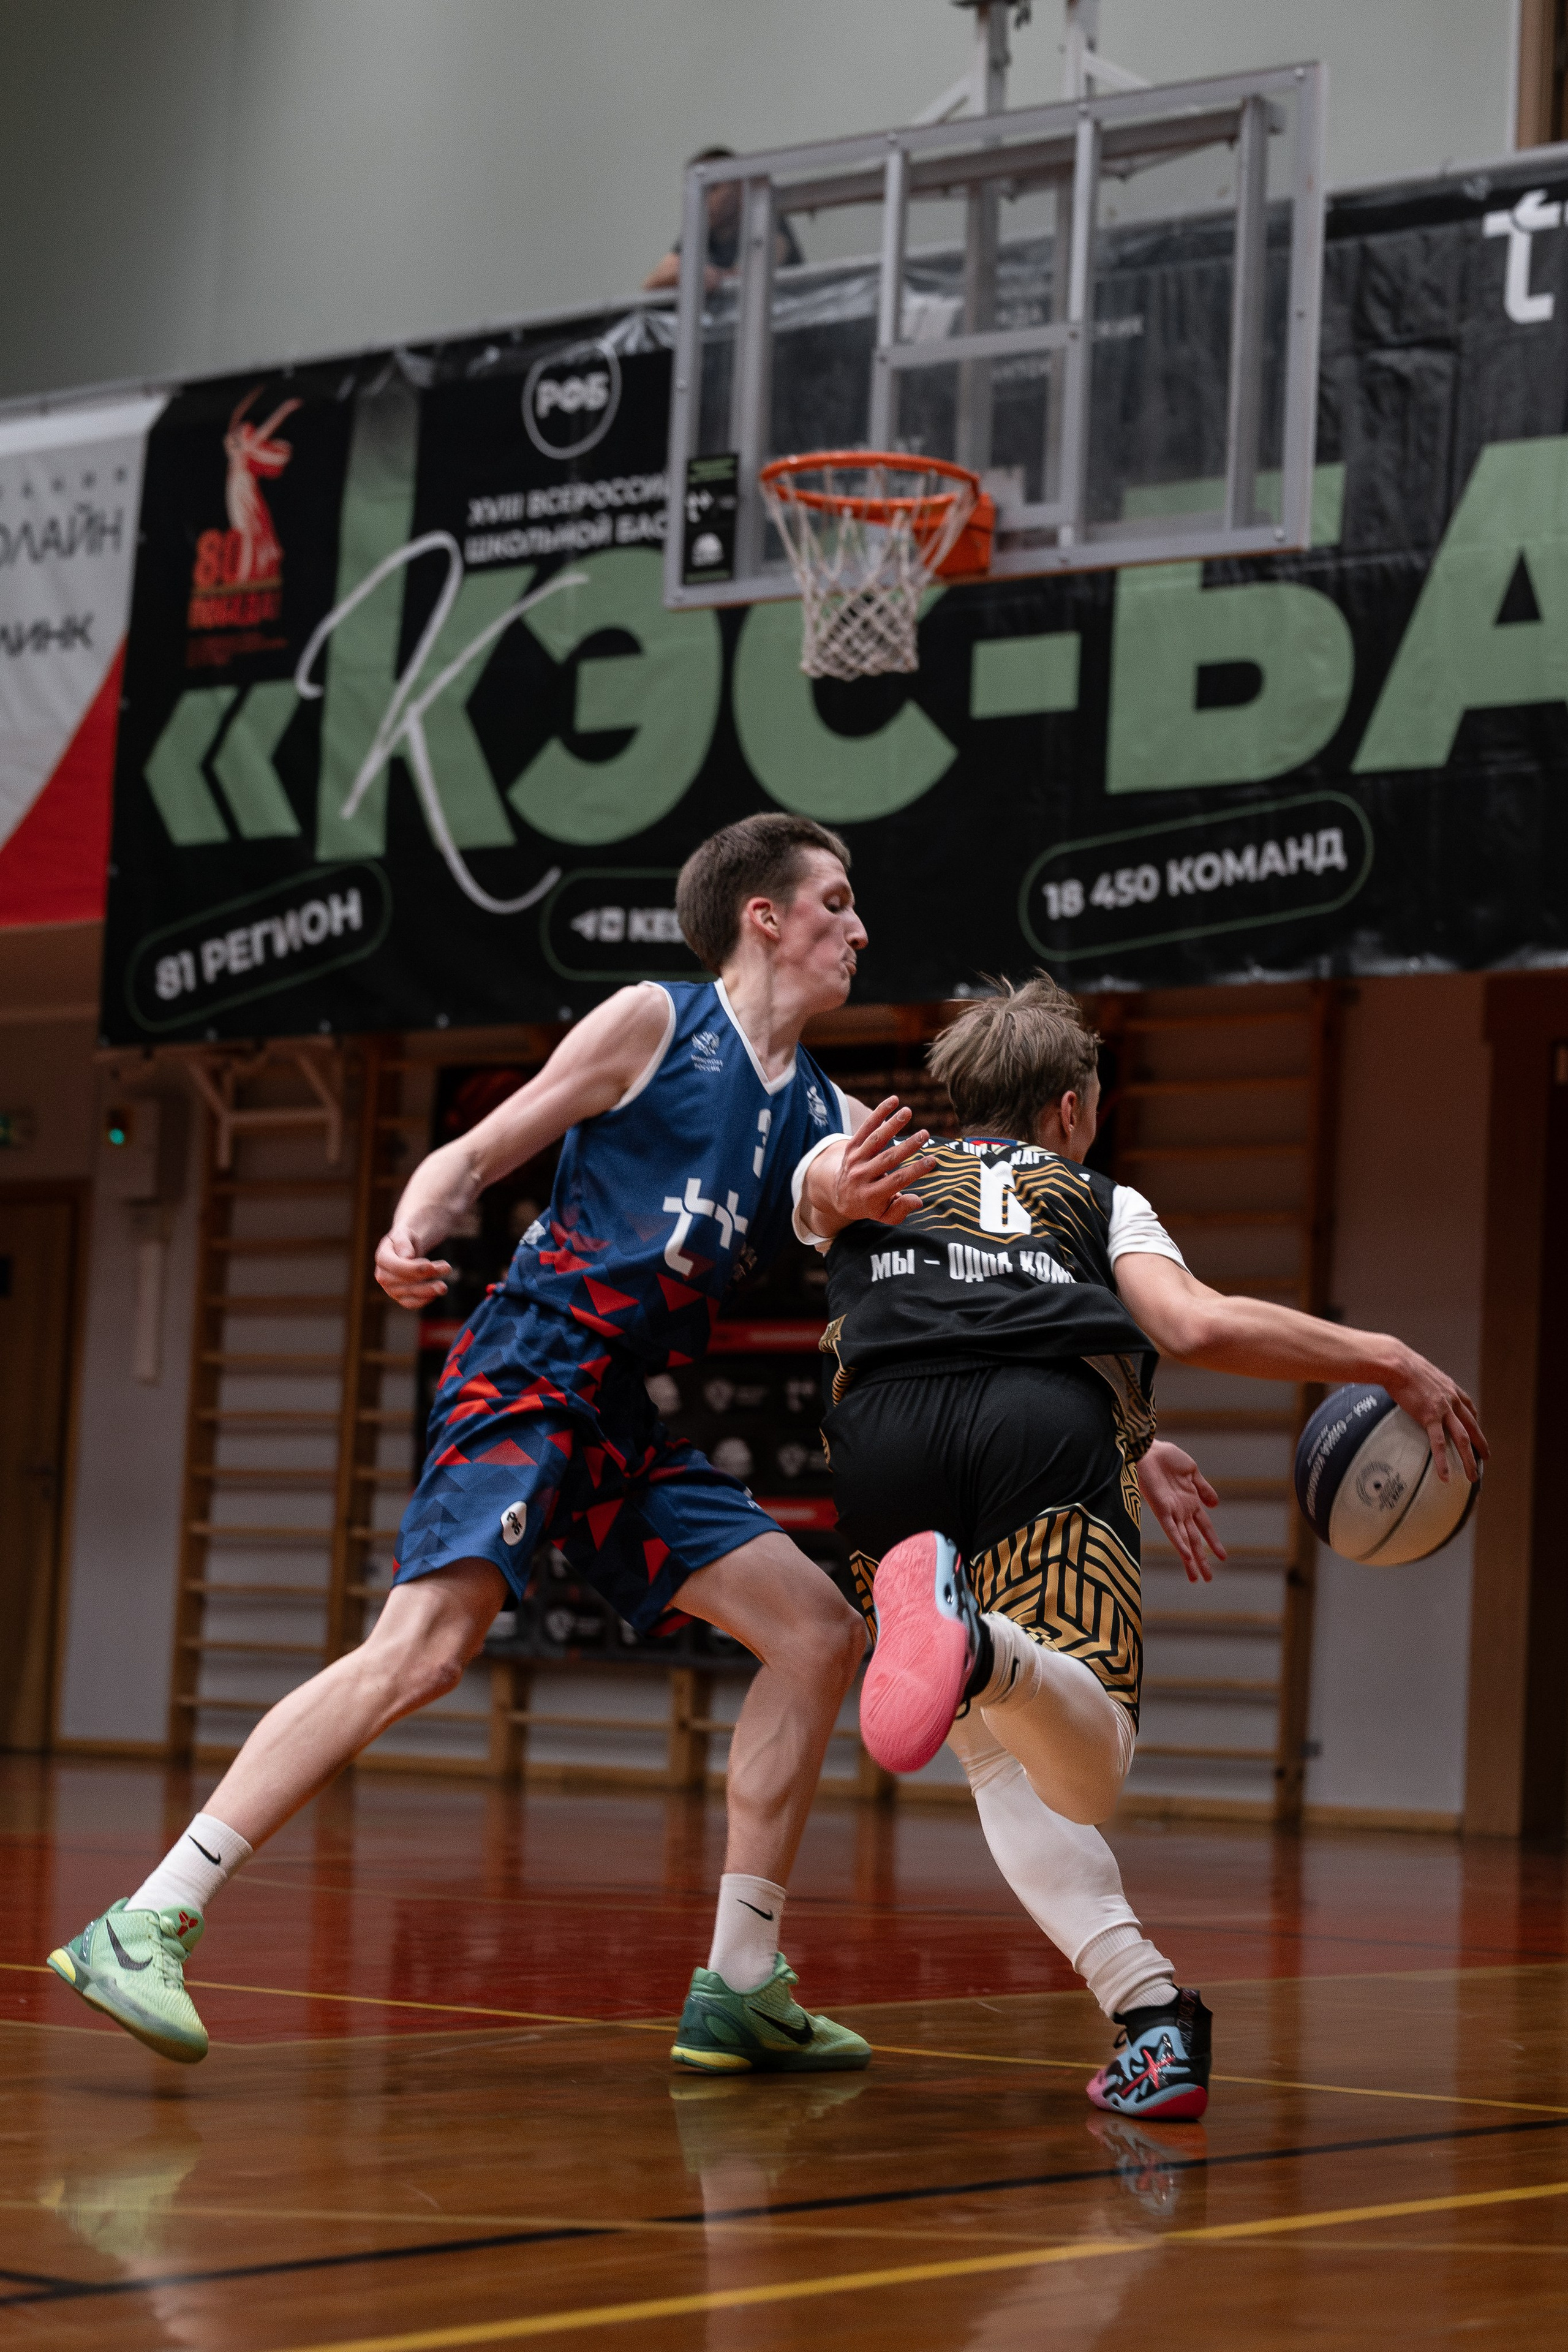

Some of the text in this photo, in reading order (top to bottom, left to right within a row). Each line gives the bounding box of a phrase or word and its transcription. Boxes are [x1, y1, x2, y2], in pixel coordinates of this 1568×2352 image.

[526, 473, 669, 519] ВСЕРОССИ
[1041, 827, 1348, 921] 18 450 КОМАНД
[154, 886, 364, 1001] 81 РЕГИОН
[870, 1248, 916, 1283] МЫ
